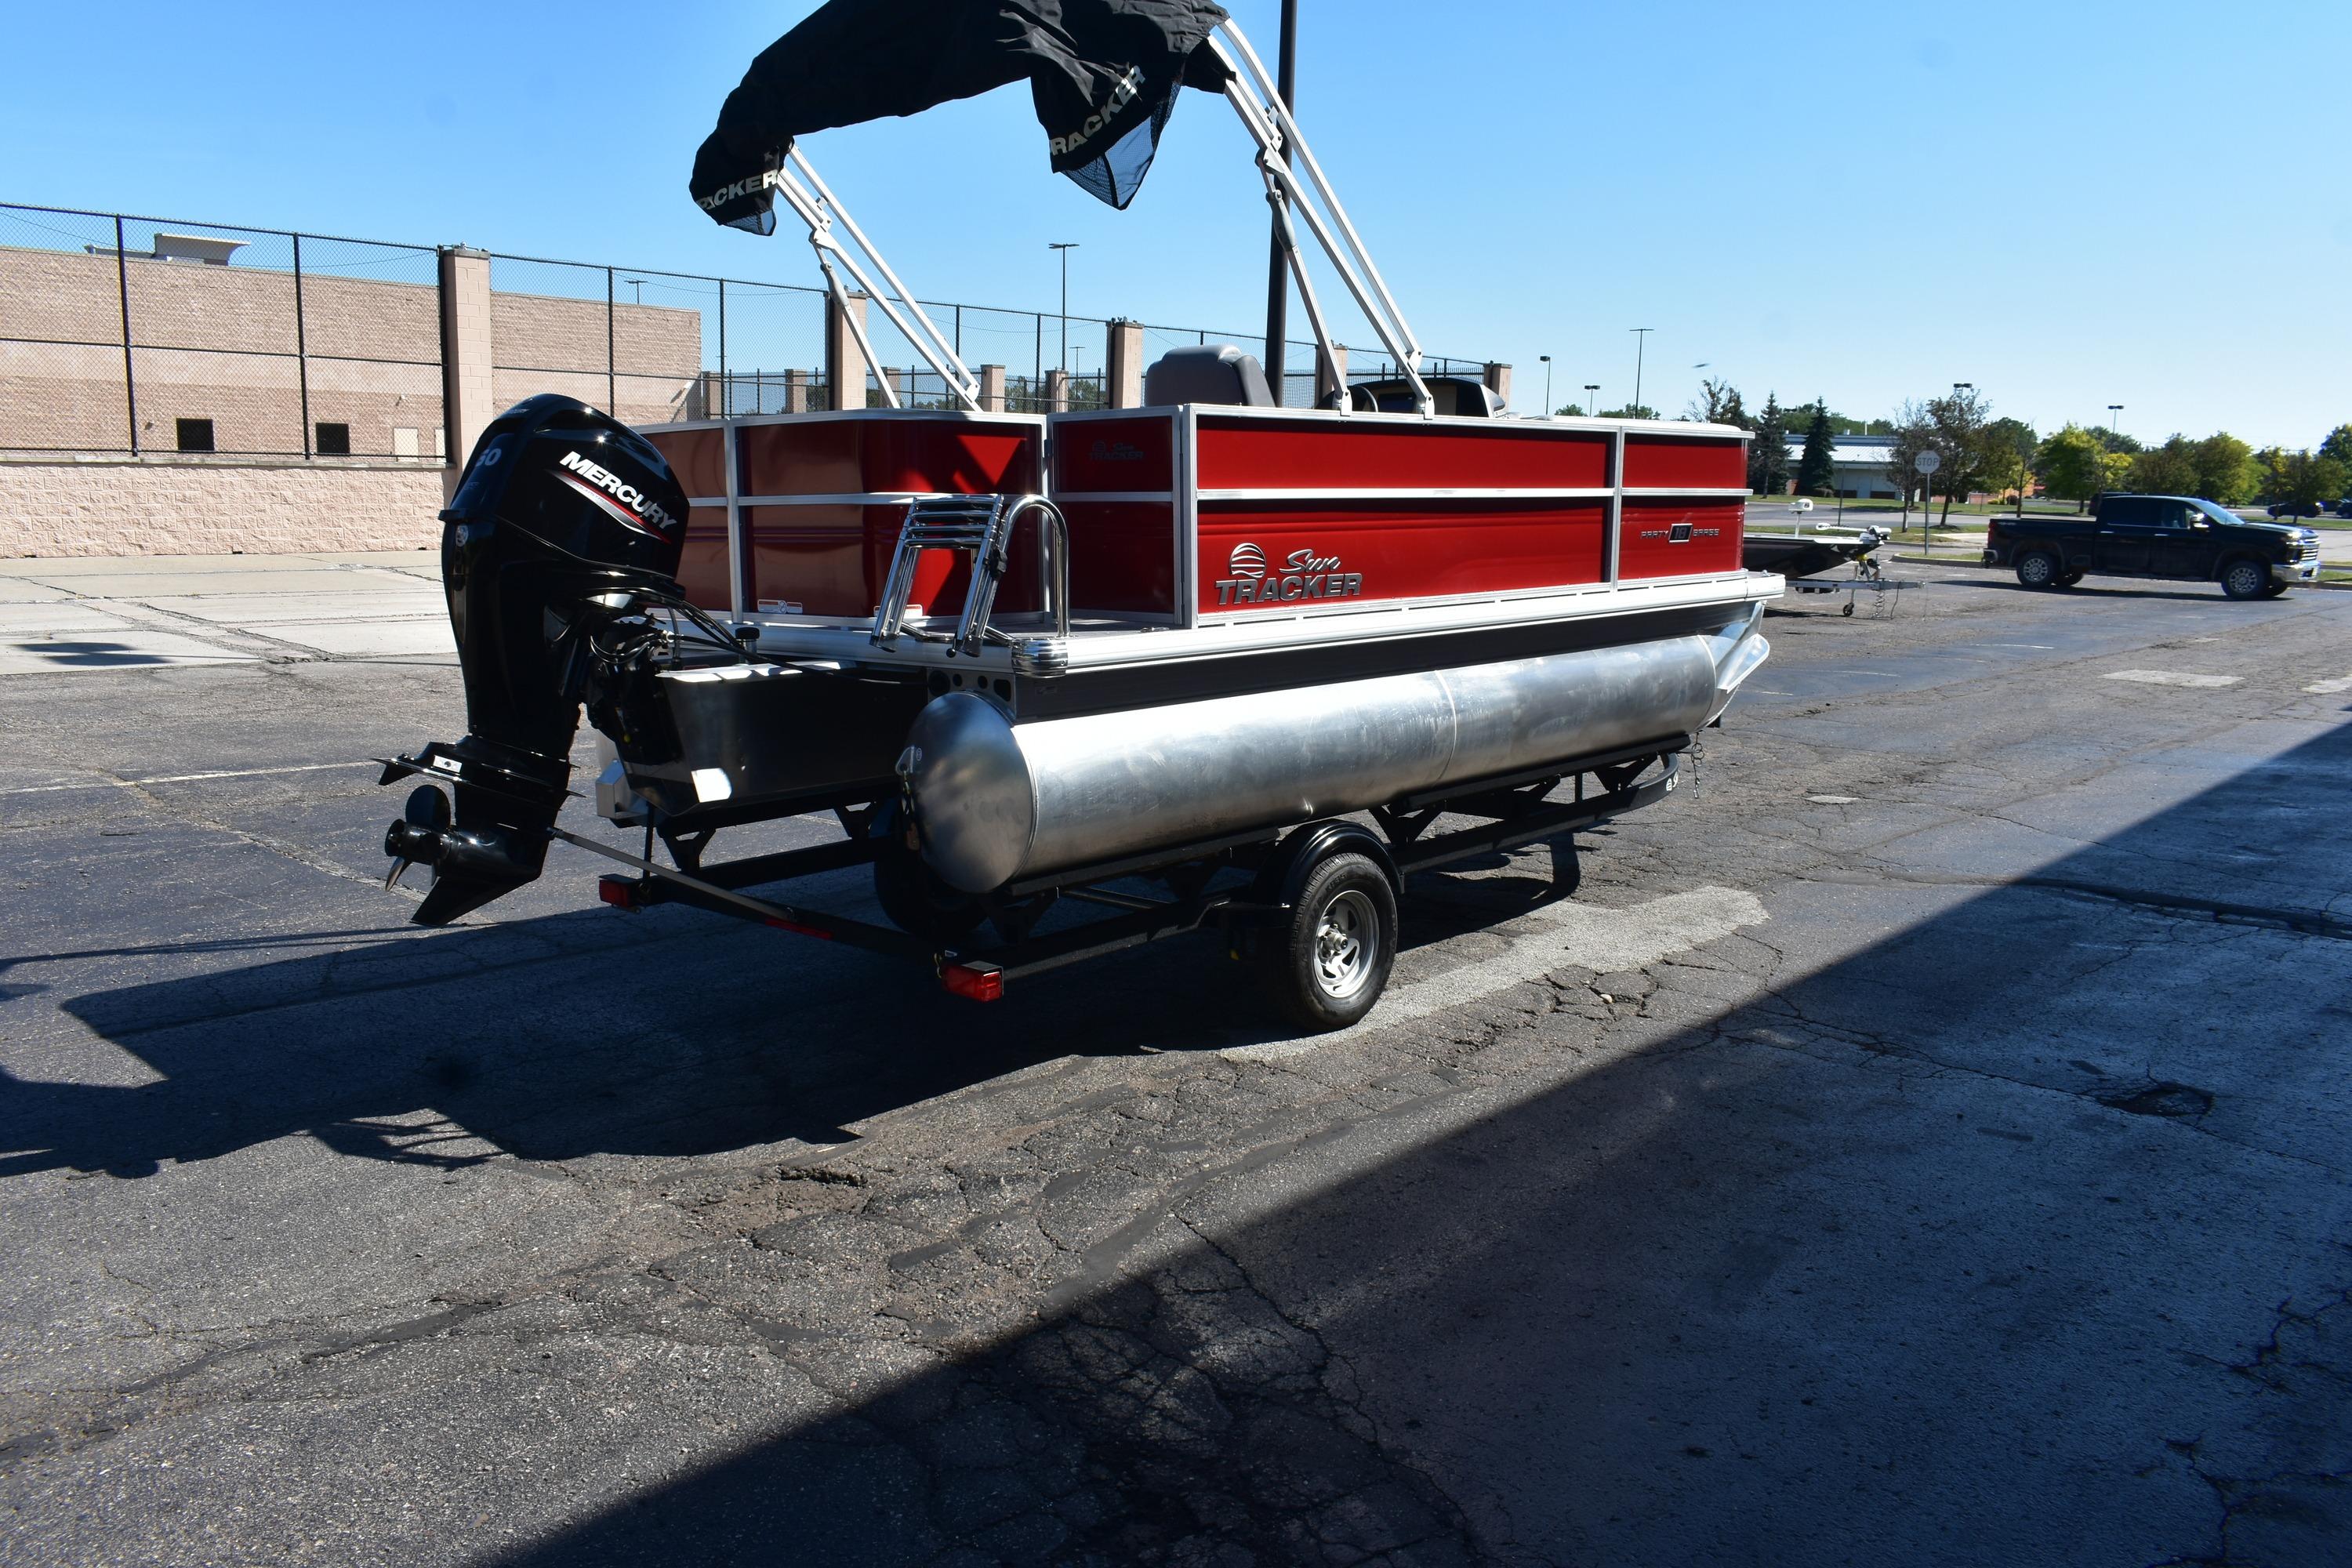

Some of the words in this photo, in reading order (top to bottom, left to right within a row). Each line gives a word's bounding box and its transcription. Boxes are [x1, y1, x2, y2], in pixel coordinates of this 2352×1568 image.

[1049, 65, 1145, 156] RACKER
[1917, 457, 1939, 466] STOP
[559, 451, 677, 529] MERCURY
[1641, 531, 1668, 539] PARTY
[1674, 526, 1688, 539] 18
[1693, 528, 1720, 537] BARGE
[1279, 549, 1341, 574] Sun
[1215, 572, 1363, 605] TRACKER
